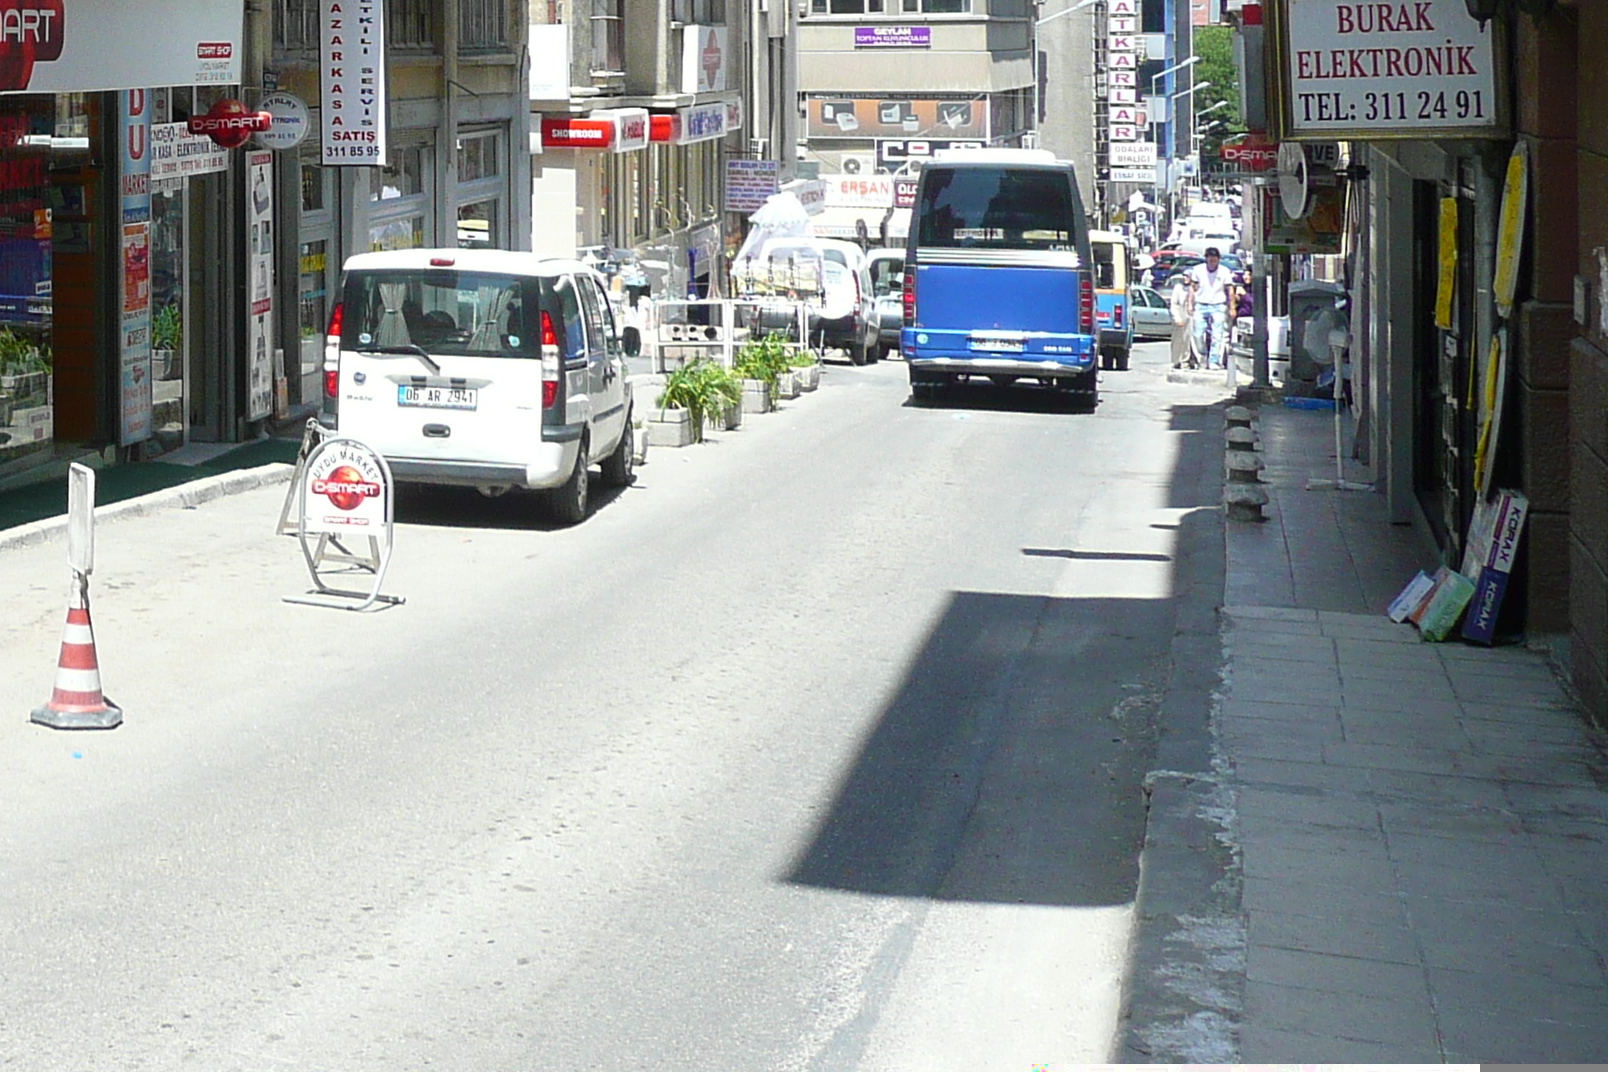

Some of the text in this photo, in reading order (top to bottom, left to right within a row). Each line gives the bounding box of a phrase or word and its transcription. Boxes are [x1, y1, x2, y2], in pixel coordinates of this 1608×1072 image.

[1336, 2, 1435, 34] BURAK
[1297, 38, 1477, 79] ELEKTRONİK
[1298, 89, 1484, 122] TEL: 311 24 91
[193, 116, 261, 130] D-SMART
[332, 130, 375, 144] SATIŞ
[551, 128, 603, 139] SHOWROOM
[326, 144, 380, 157] 311 85 95
[1224, 149, 1278, 160] D-SMA
[840, 180, 890, 195] ERSAN
[405, 388, 473, 404] 06 AR 2941
[313, 450, 379, 480] UYDU MARKET
[313, 482, 378, 495] D-SMART
[1498, 506, 1522, 564] KORAX
